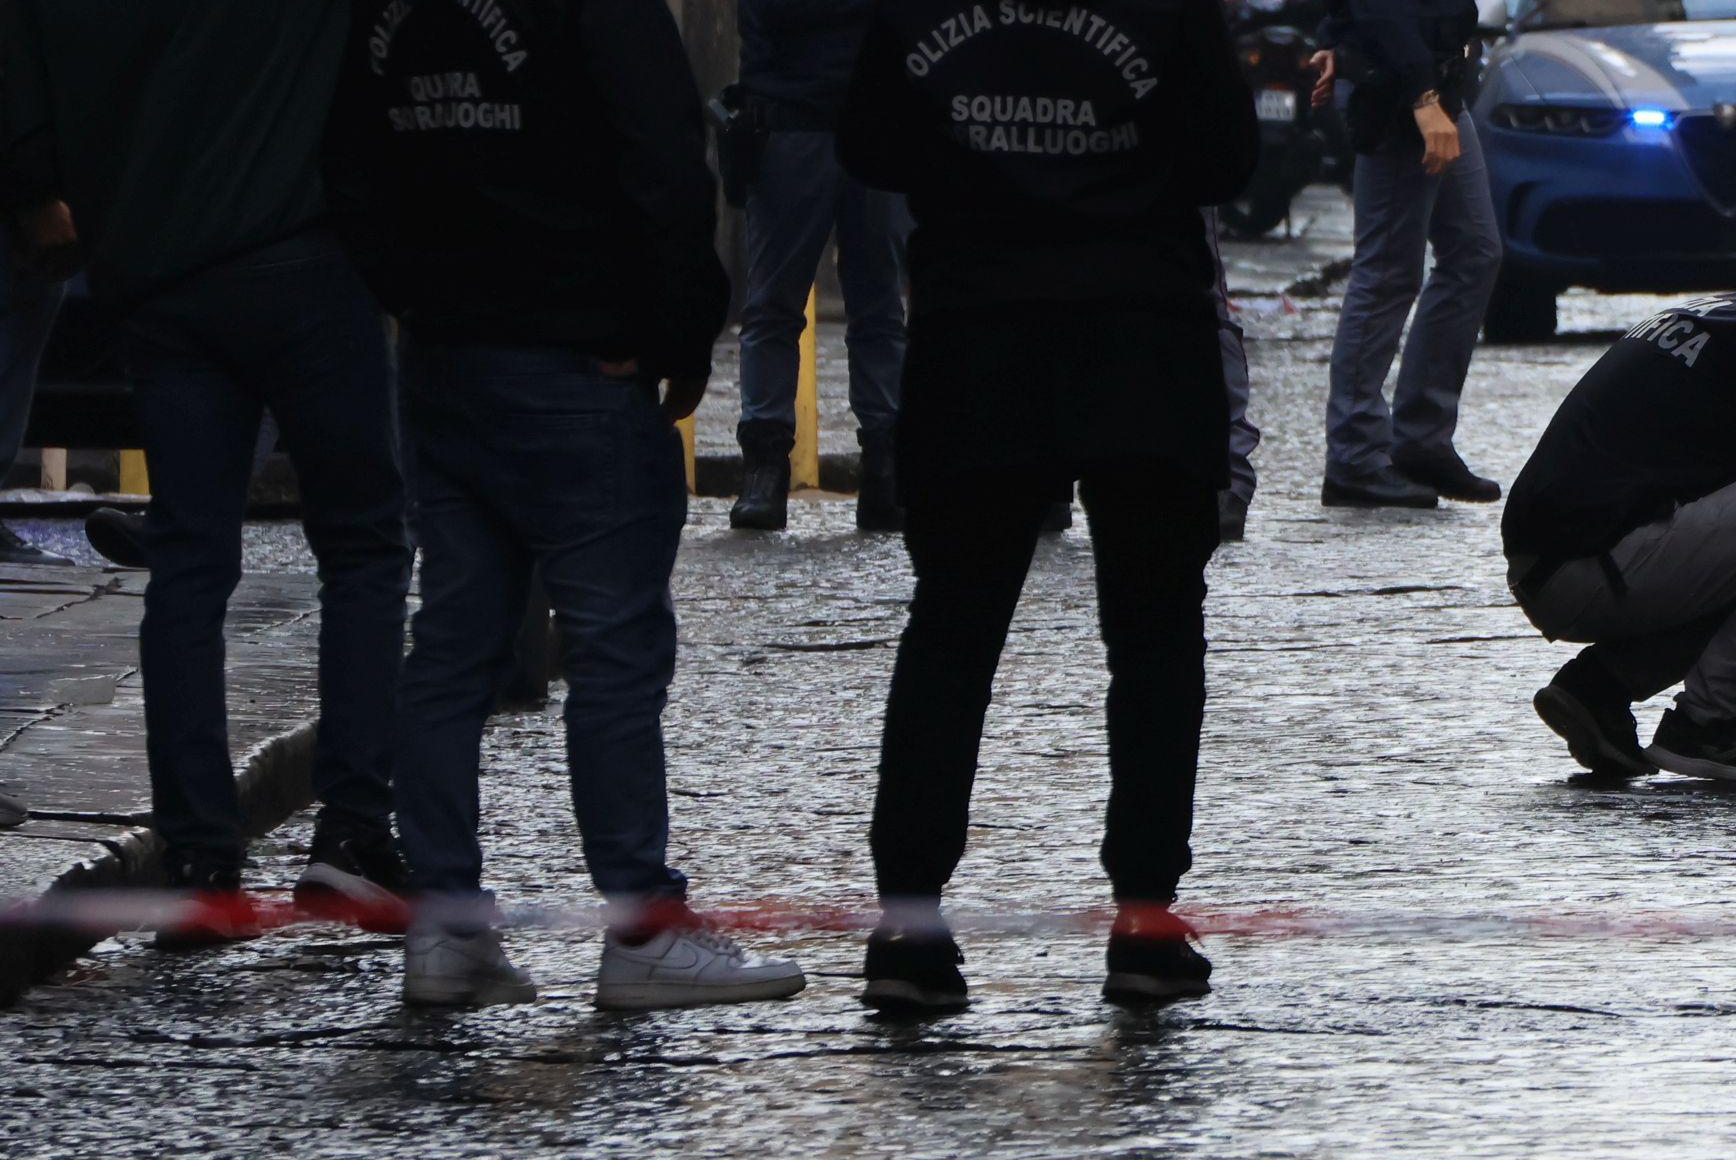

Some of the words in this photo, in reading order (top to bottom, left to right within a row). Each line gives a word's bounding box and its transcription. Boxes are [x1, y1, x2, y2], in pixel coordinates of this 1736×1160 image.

[904, 2, 993, 78] OLIZIA
[950, 94, 1097, 127] SQUADRA
[967, 121, 1139, 156] RALLUOGHI
